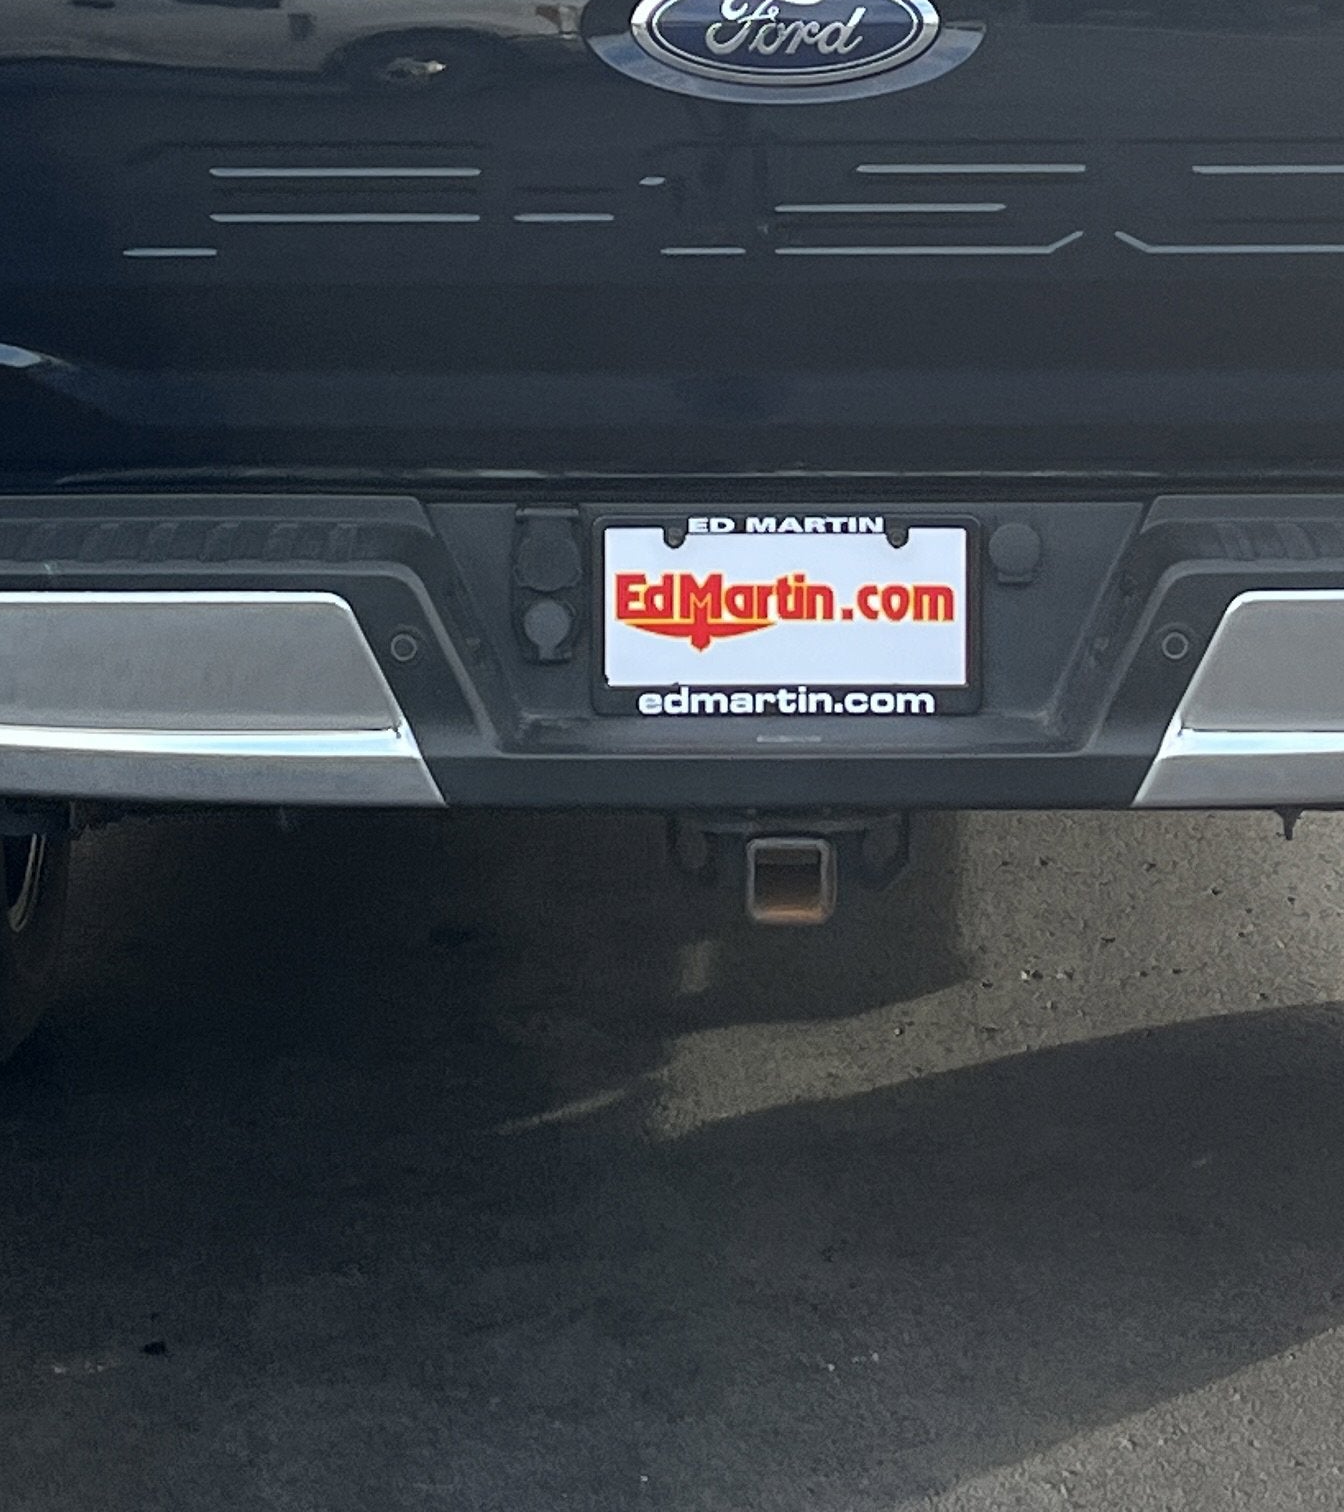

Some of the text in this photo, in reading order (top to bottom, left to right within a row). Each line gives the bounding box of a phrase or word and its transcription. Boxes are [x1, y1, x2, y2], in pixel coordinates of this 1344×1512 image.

[687, 516, 885, 534] ED MARTIN
[614, 571, 956, 643] EdMartin.com
[637, 686, 936, 715] edmartin.com
